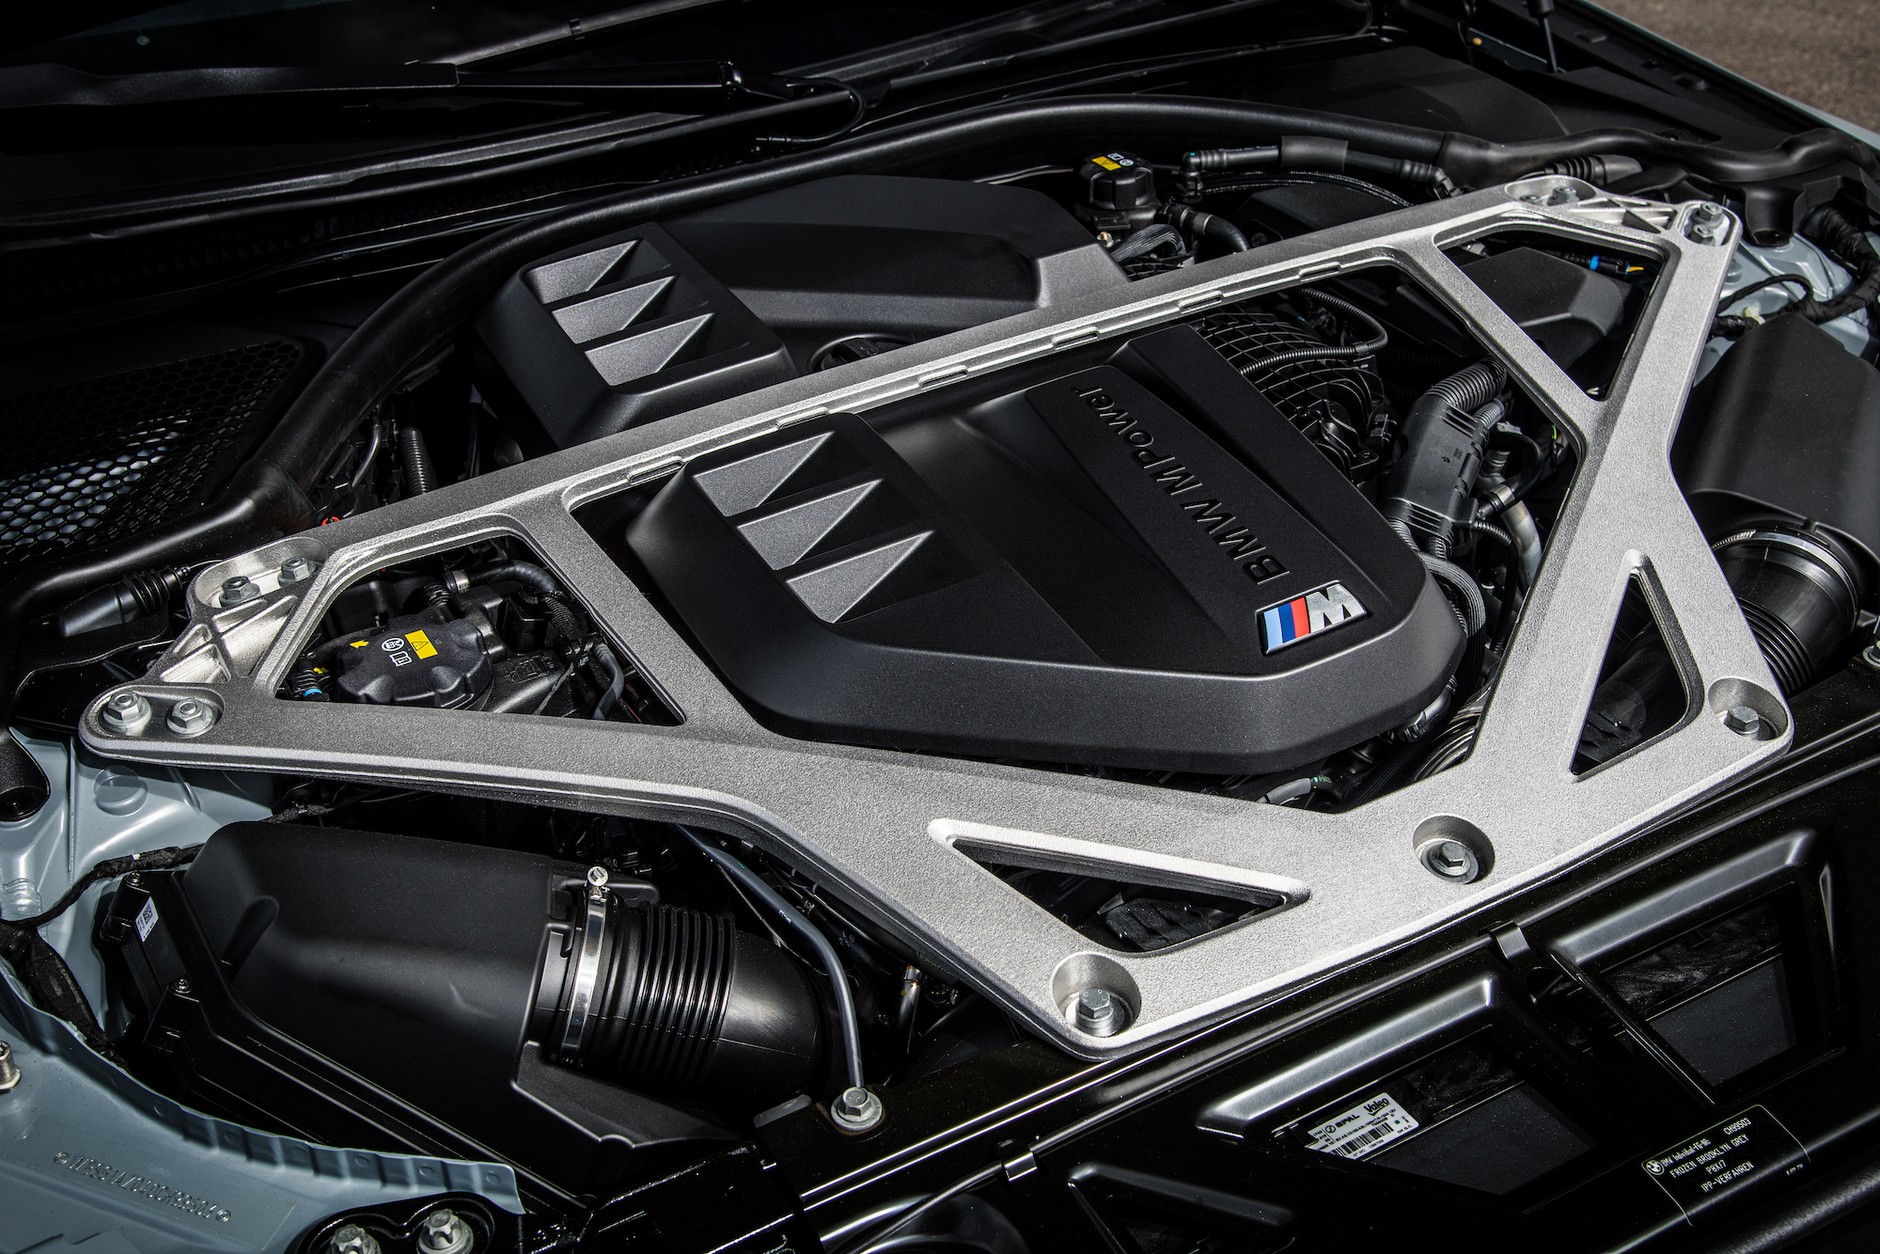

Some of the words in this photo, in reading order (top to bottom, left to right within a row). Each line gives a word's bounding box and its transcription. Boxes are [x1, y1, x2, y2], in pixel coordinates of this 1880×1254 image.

[1182, 498, 1290, 584] BMW
[1363, 1098, 1390, 1114] Valeo
[1723, 1117, 1752, 1135] CH99503
[1669, 1160, 1698, 1178] FROZEN
[1696, 1143, 1732, 1165] BROOKLYN
[1730, 1134, 1749, 1147] GREY
[1700, 1161, 1755, 1192] IPP-VERFAHREN
